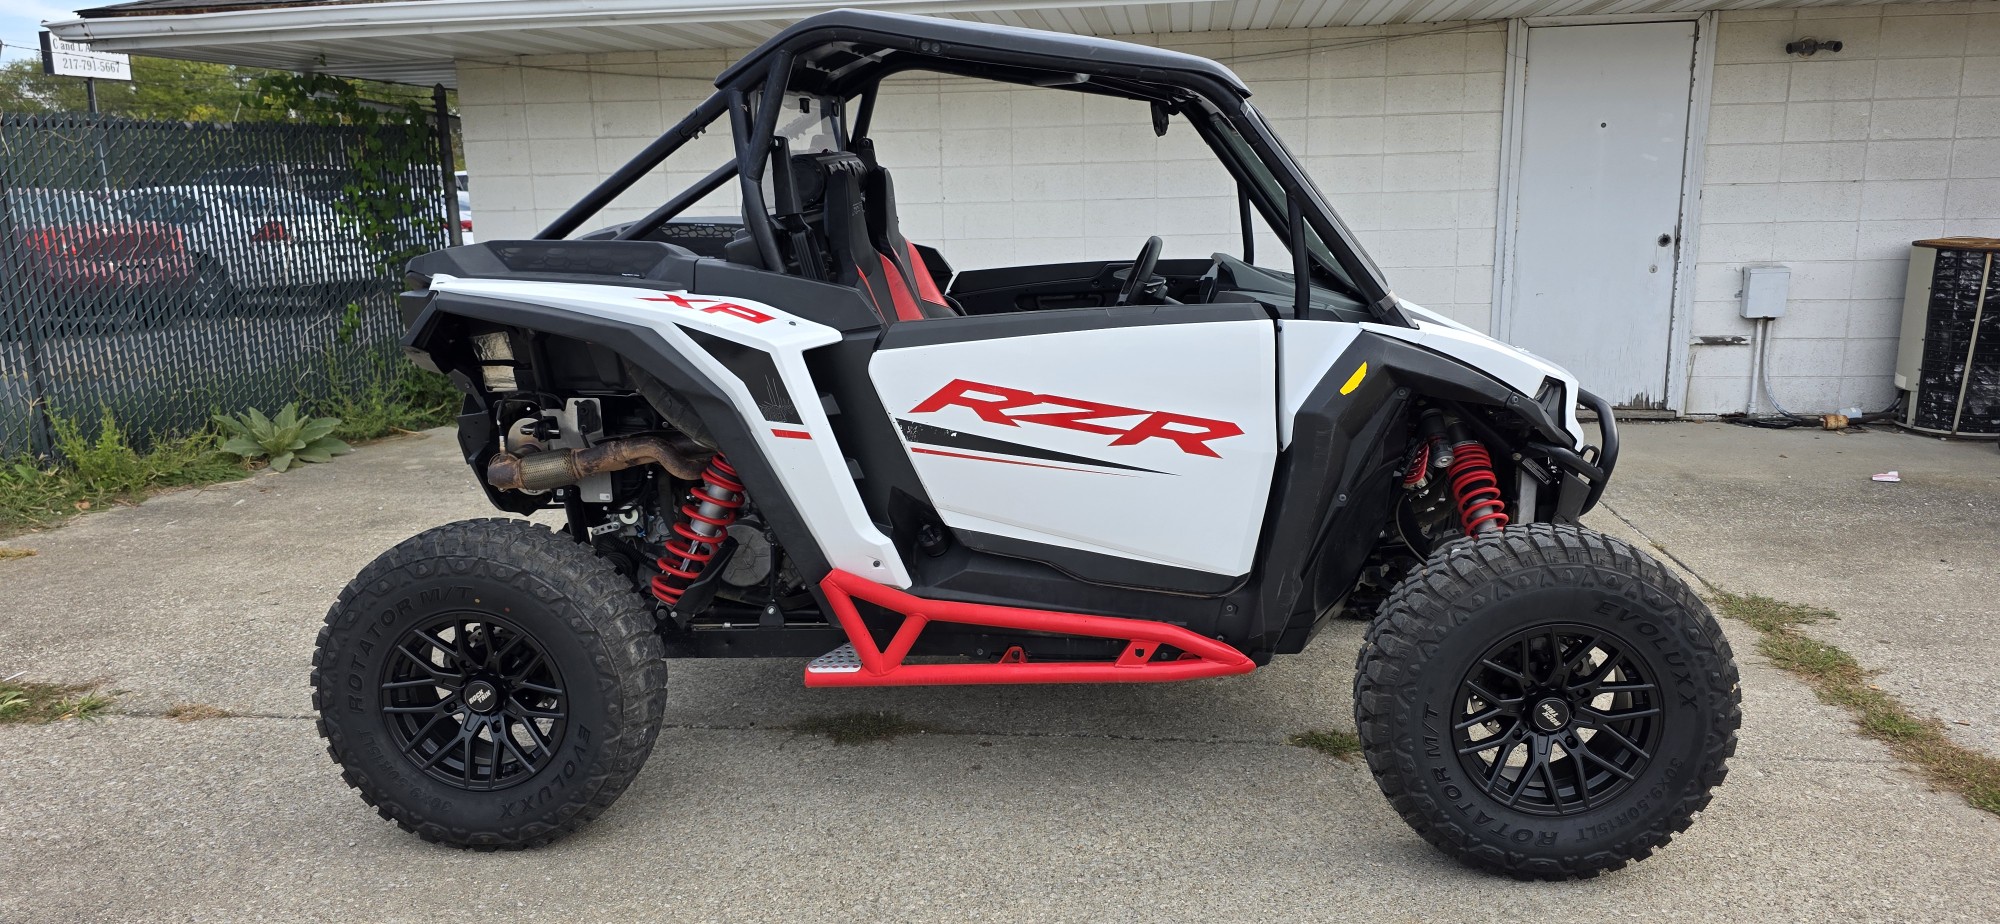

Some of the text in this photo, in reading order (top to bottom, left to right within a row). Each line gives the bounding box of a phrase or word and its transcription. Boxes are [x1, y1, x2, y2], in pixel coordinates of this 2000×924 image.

[52, 38, 59, 50] C
[60, 43, 75, 51] and
[62, 57, 120, 73] 217-791-5667
[634, 293, 776, 324] XP
[908, 378, 1245, 459] RZR
[346, 585, 473, 714] ROTATOR M/T
[1592, 600, 1699, 712] EVOLUXX
[500, 722, 592, 819] EVOLUXX
[1423, 702, 1558, 848] ROTATOR M/T
